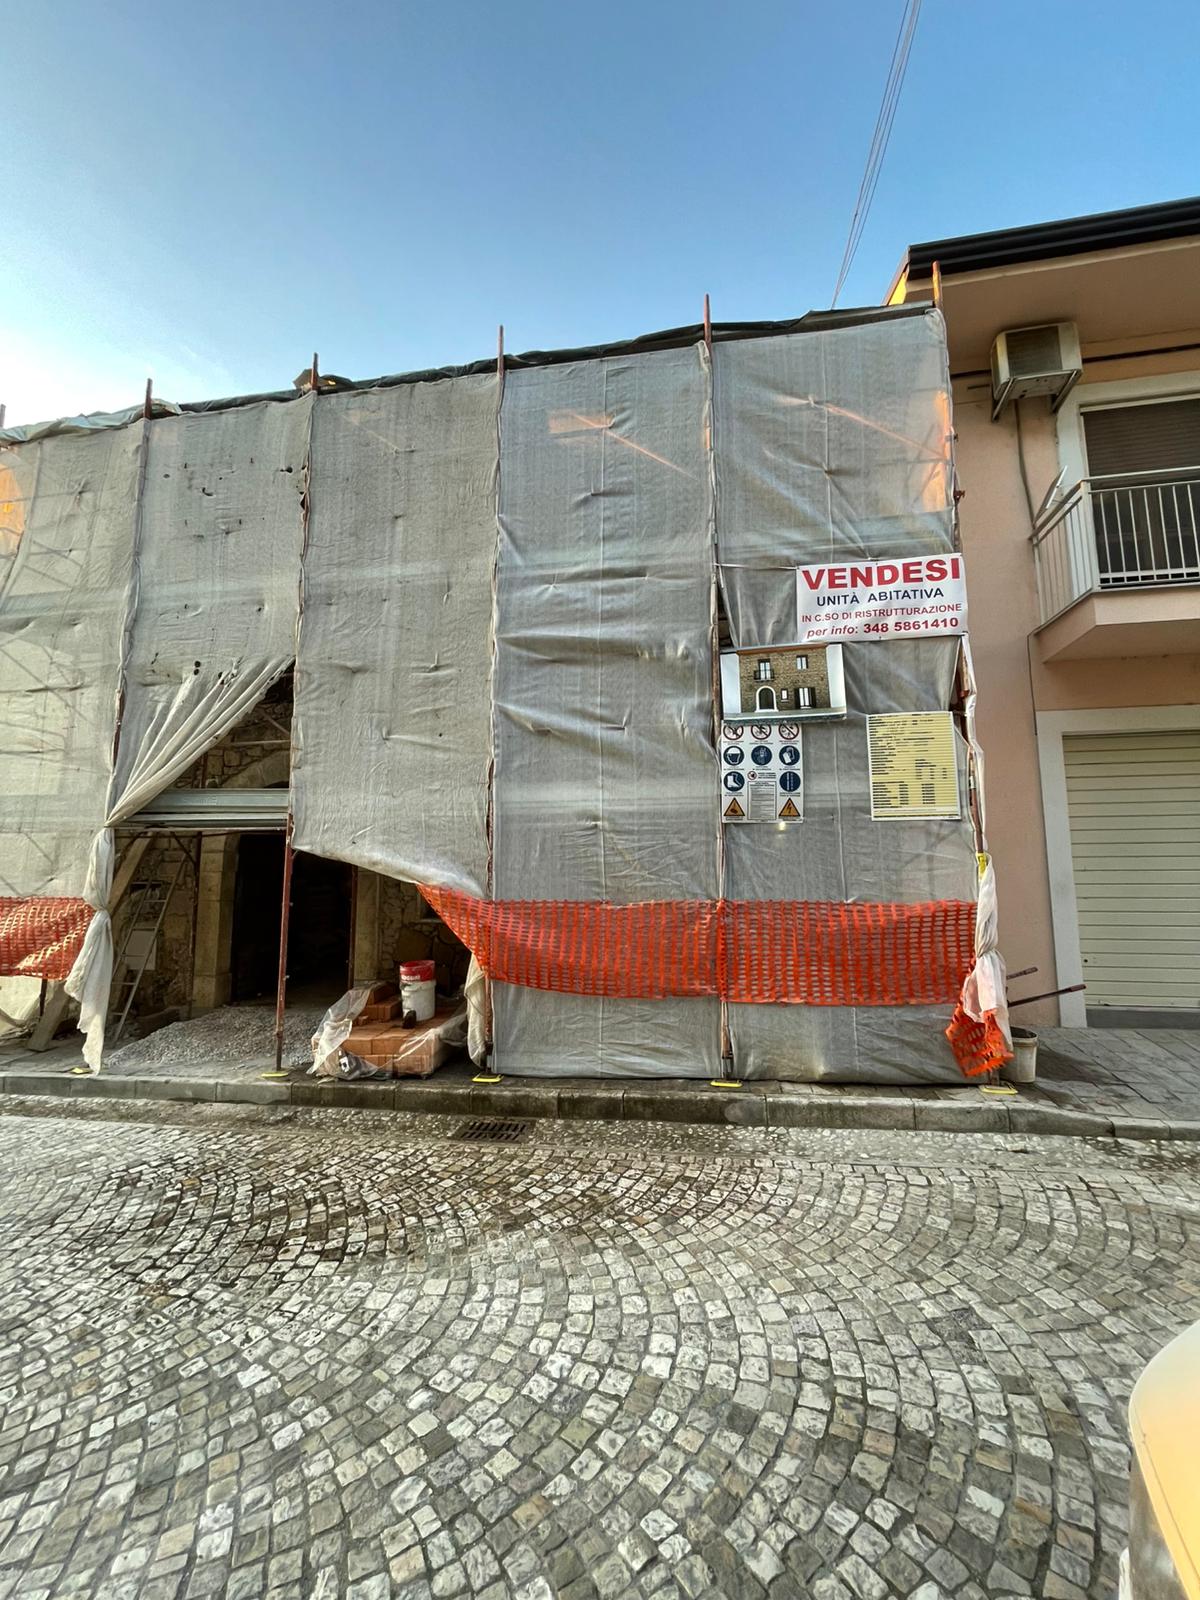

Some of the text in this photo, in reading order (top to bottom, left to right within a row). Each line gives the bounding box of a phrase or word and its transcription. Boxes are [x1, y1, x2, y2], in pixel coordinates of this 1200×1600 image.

[802, 558, 960, 590] VENDESI
[817, 588, 944, 606] UNITÀ ABITATIVA
[814, 612, 838, 622] C.SO
[842, 612, 852, 620] DI
[855, 603, 962, 619] RISTRUTTURAZIONE
[807, 617, 959, 639] per info: 348 5861410
